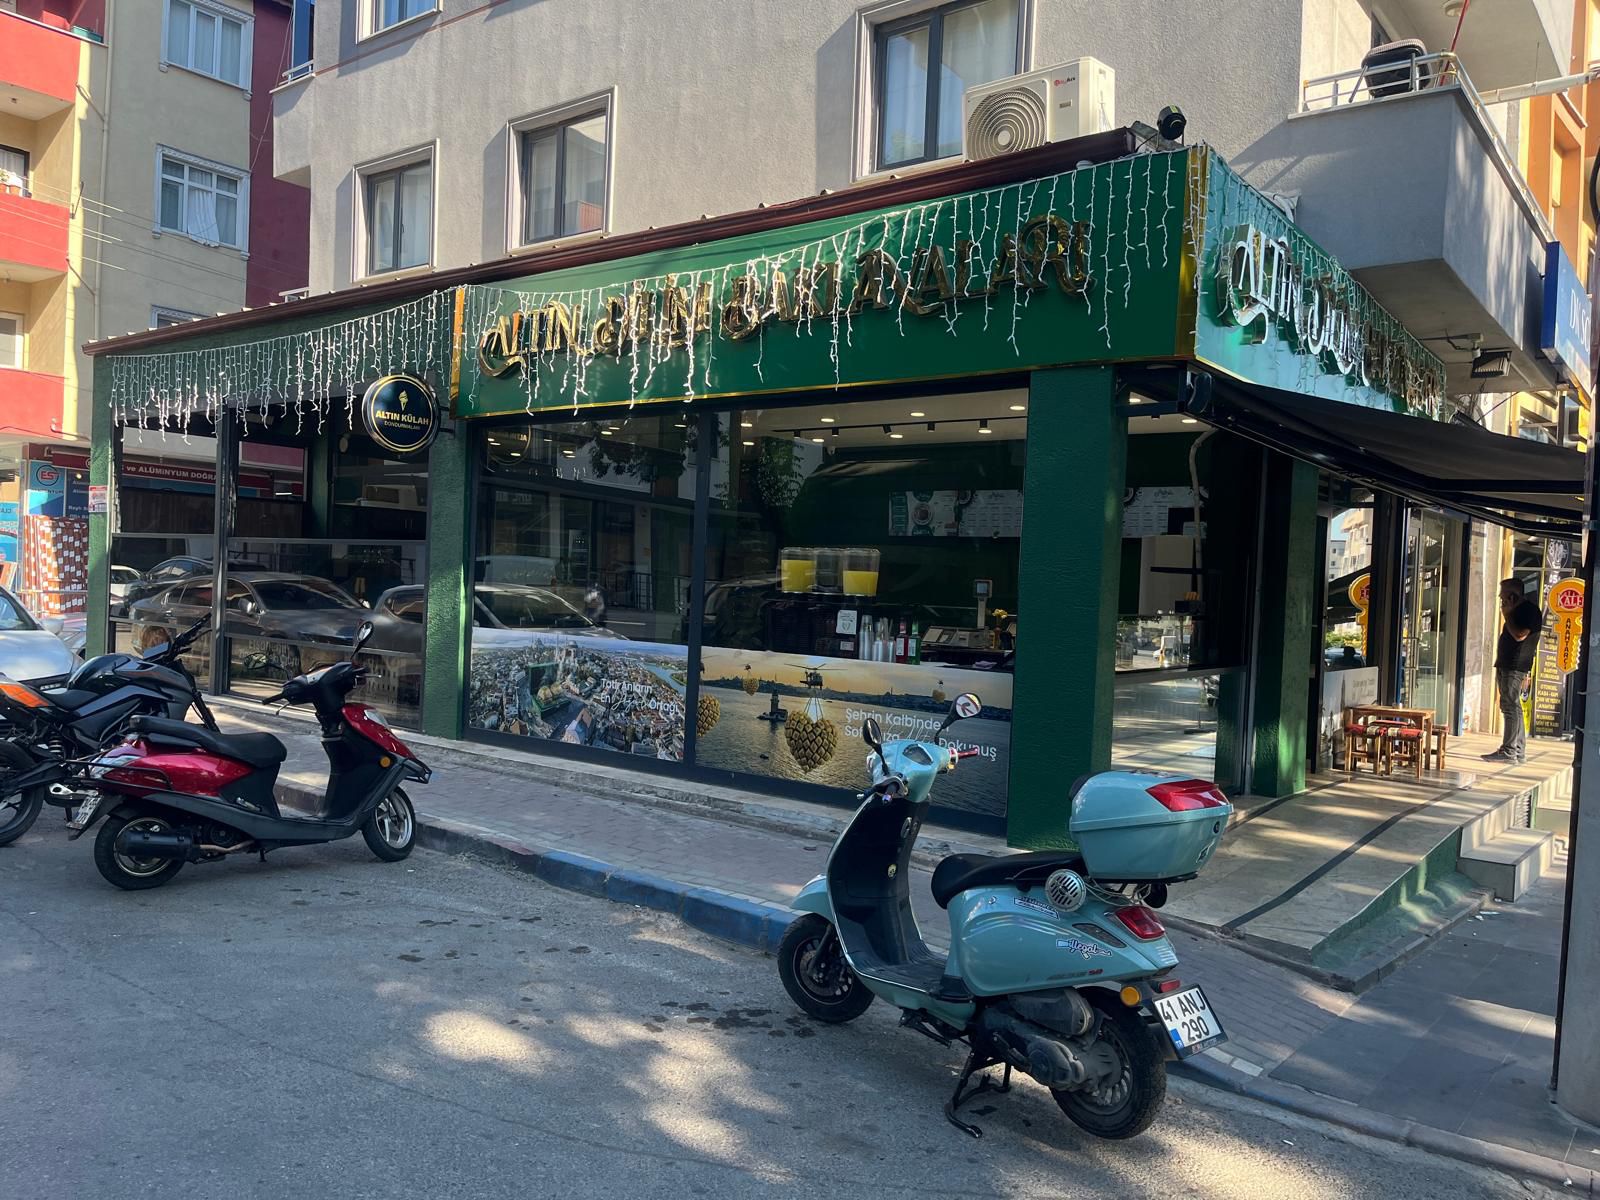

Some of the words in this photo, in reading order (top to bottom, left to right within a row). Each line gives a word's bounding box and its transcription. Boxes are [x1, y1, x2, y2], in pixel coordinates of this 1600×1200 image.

[480, 300, 597, 377] ALTIN
[375, 410, 400, 421] ALTIN
[401, 413, 429, 425] KÜLAH
[138, 465, 189, 478] ALÜMİNYUM
[600, 692, 611, 703] En
[649, 697, 679, 715] Ortağı
[845, 707, 883, 723] Şehrin
[1160, 1000, 1179, 1022] 41
[1177, 990, 1206, 1018] ANJ
[1181, 1015, 1210, 1042] 290
